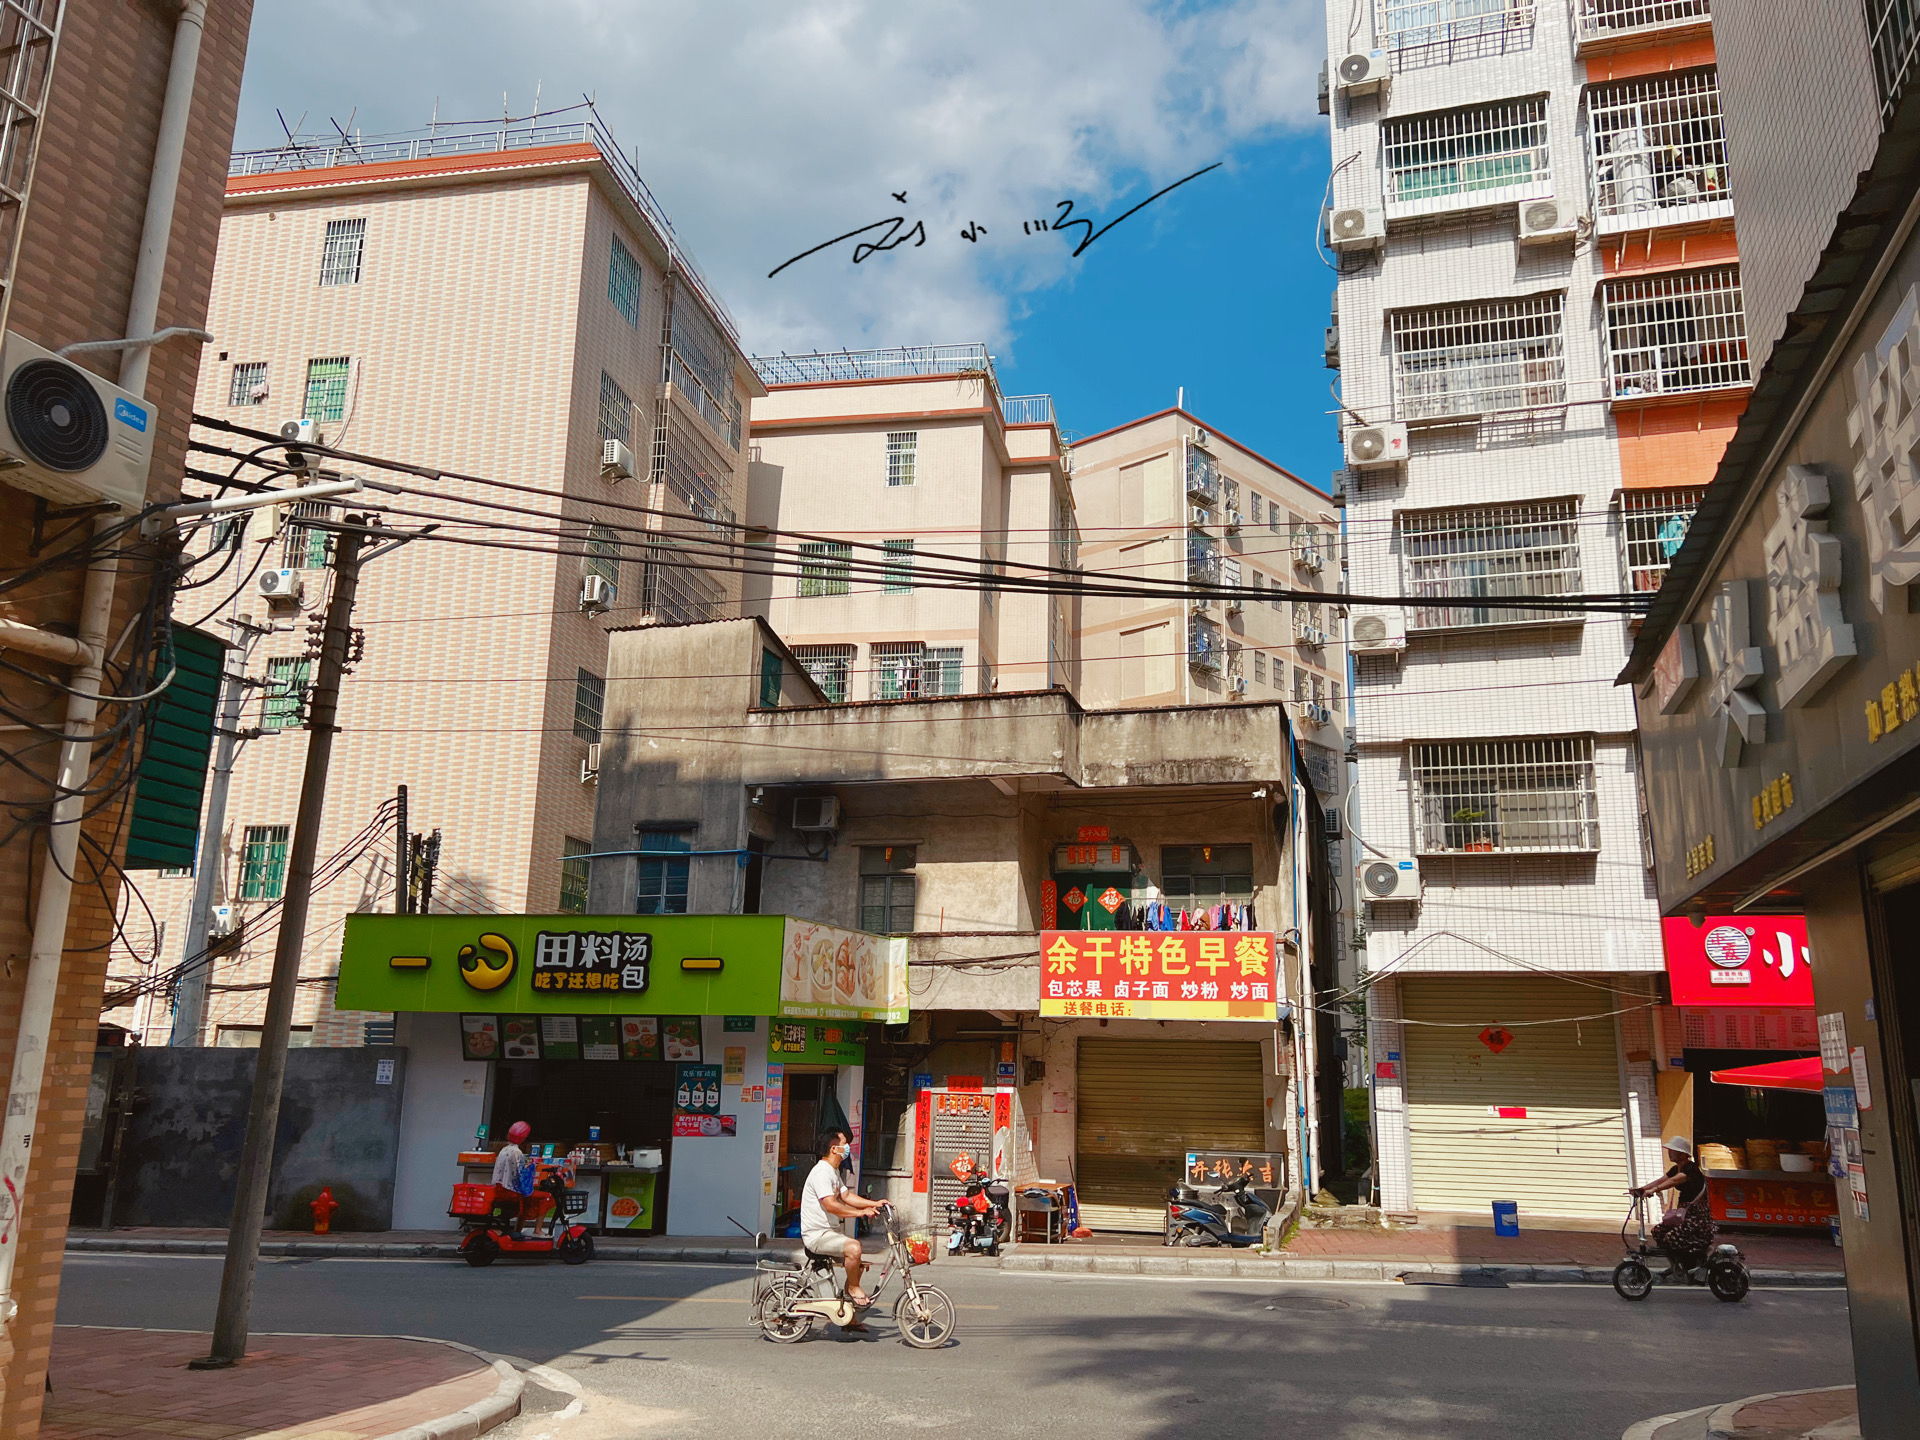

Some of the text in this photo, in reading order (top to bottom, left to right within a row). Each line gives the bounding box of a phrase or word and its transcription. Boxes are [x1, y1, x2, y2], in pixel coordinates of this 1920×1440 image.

[116, 404, 145, 427] Midea
[1865, 660, 1920, 744] 加盟热
[1067, 890, 1082, 905] 福
[1100, 890, 1119, 906] 福
[1046, 935, 1270, 976] 余干特色早餐
[535, 972, 620, 990] 吃了还想吃
[1047, 979, 1269, 1000] 包芯果 卤子面 炒粉 炒面
[1190, 1158, 1274, 1183] 开张大吉
